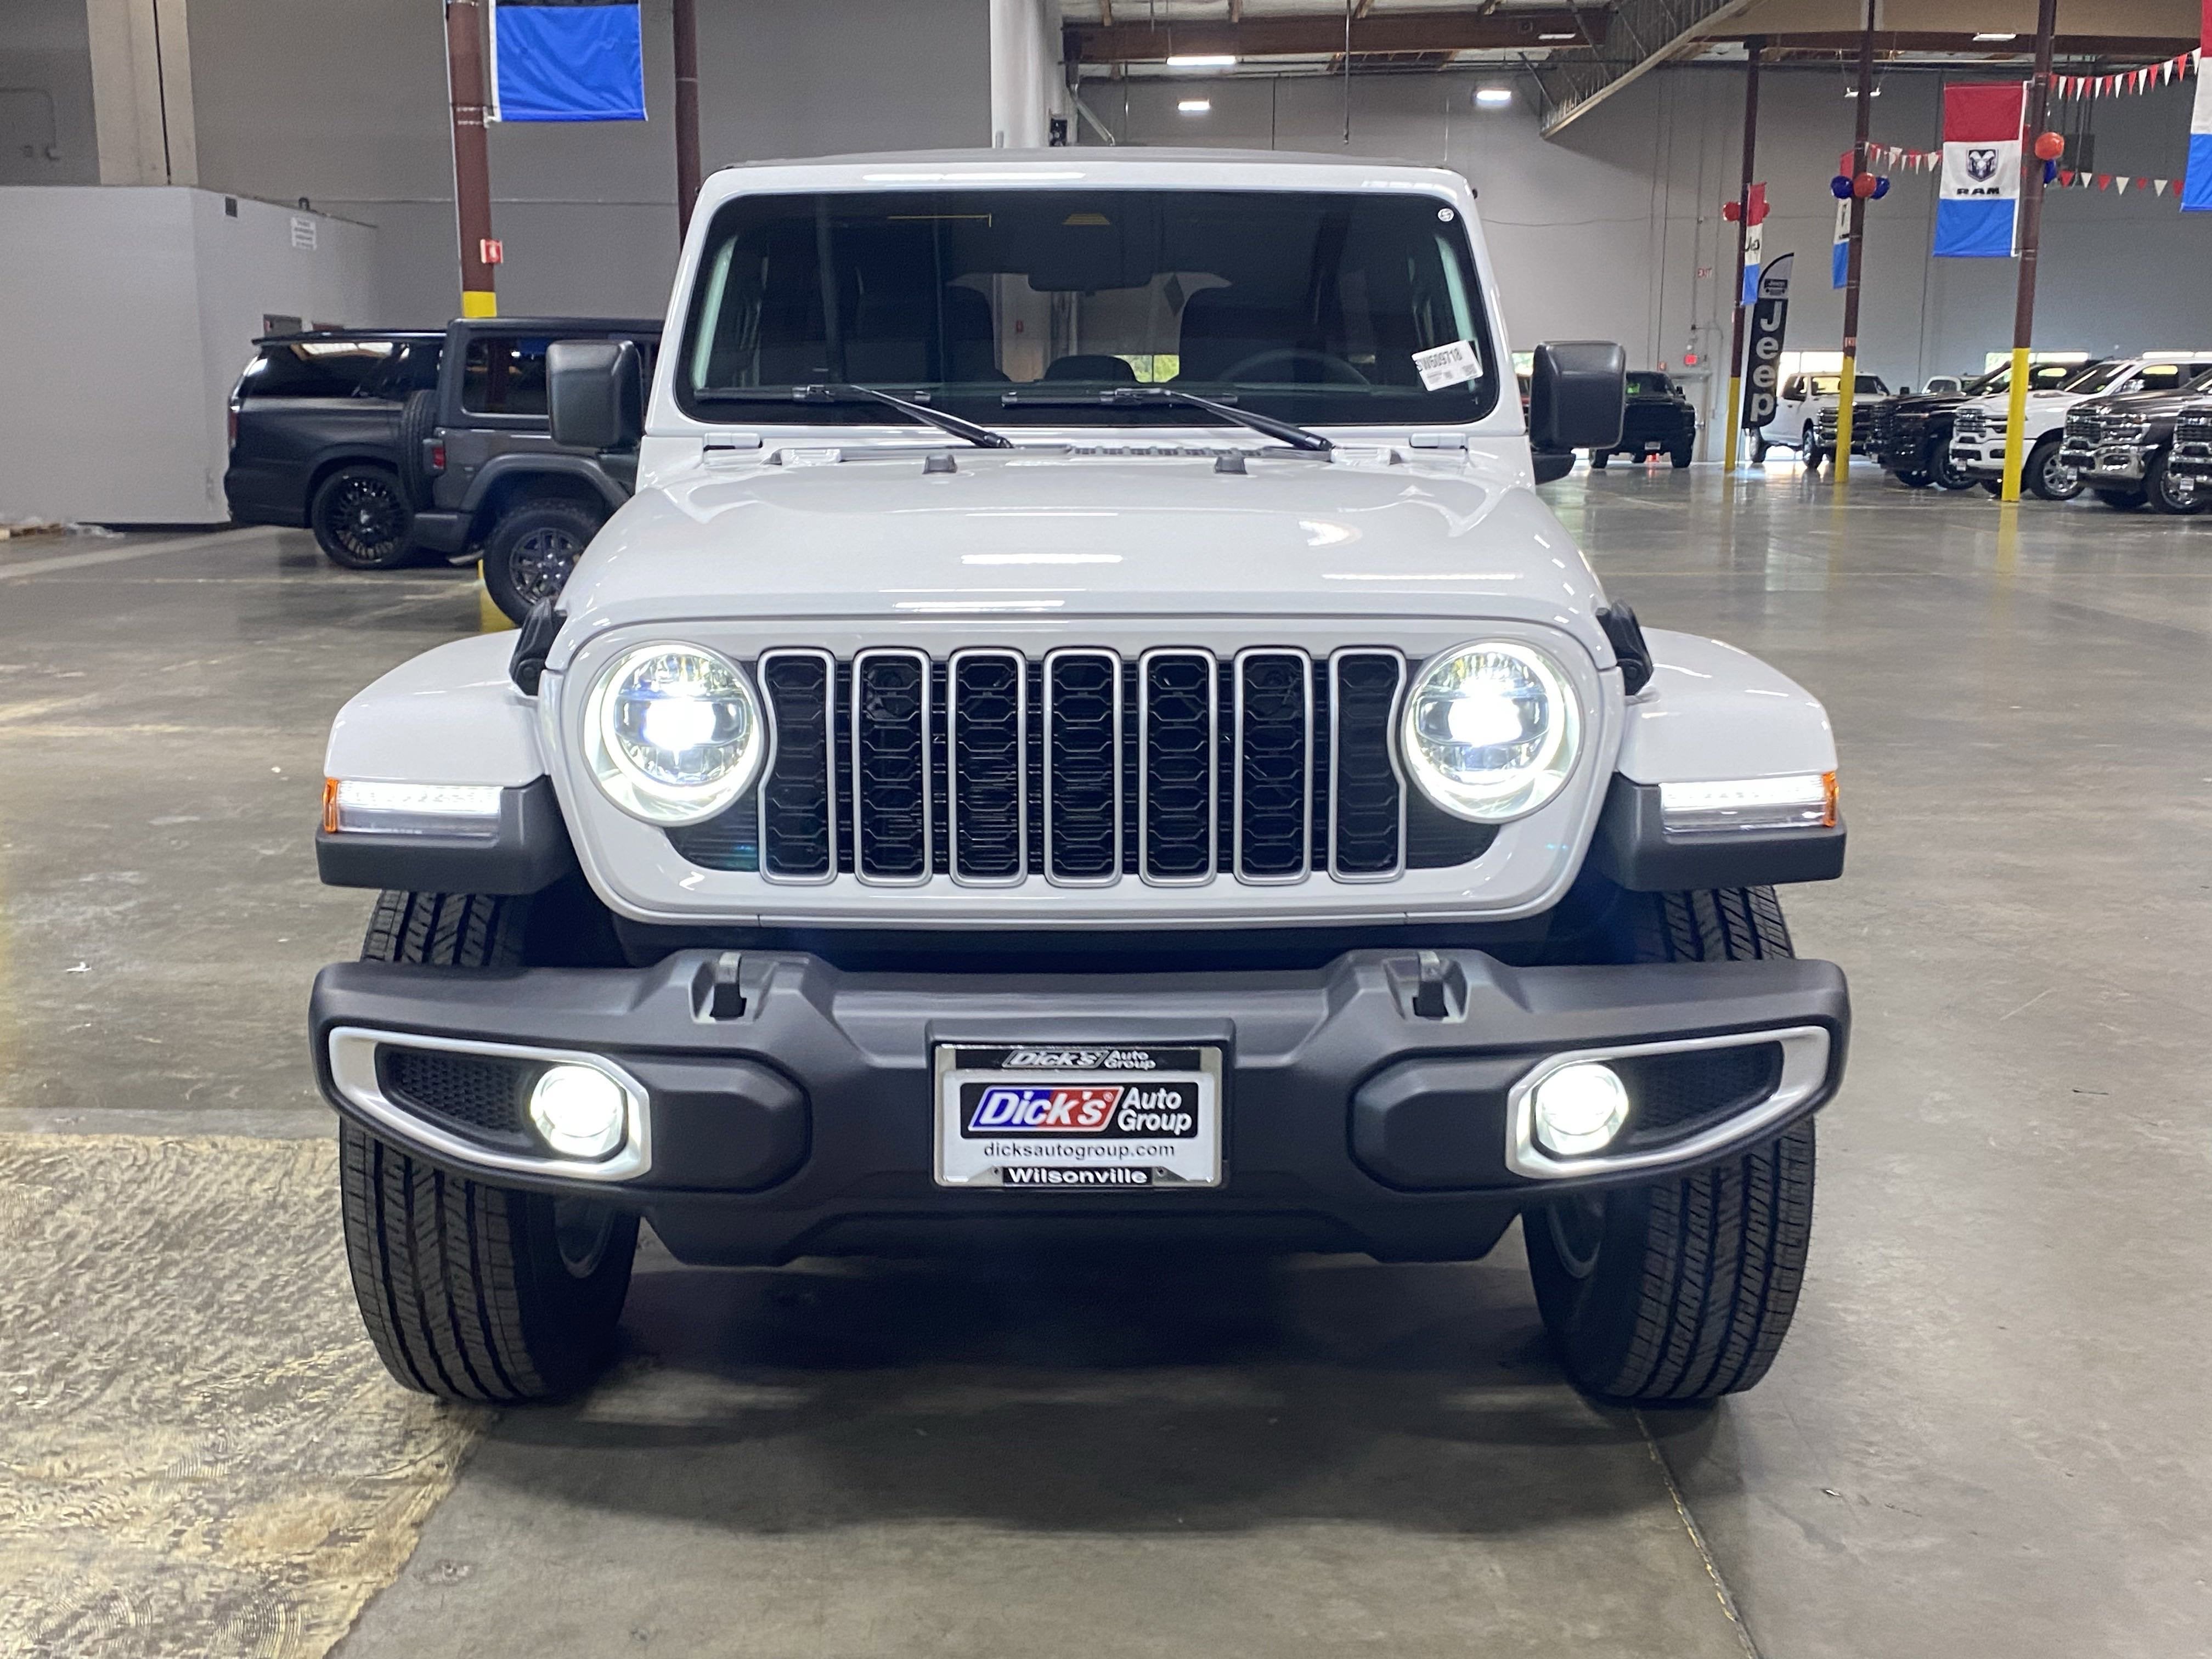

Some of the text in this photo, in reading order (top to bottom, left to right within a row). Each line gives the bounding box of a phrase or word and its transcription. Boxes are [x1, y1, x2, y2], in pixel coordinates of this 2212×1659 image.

[1750, 301, 1782, 422] Jeep
[1109, 1050, 1149, 1060] Auto
[1104, 1059, 1156, 1070] Group
[1122, 1087, 1182, 1109] Auto
[1118, 1109, 1192, 1135] Group
[984, 1142, 1175, 1160] dicksautogroup.com
[1008, 1167, 1148, 1184] Wilsonville
